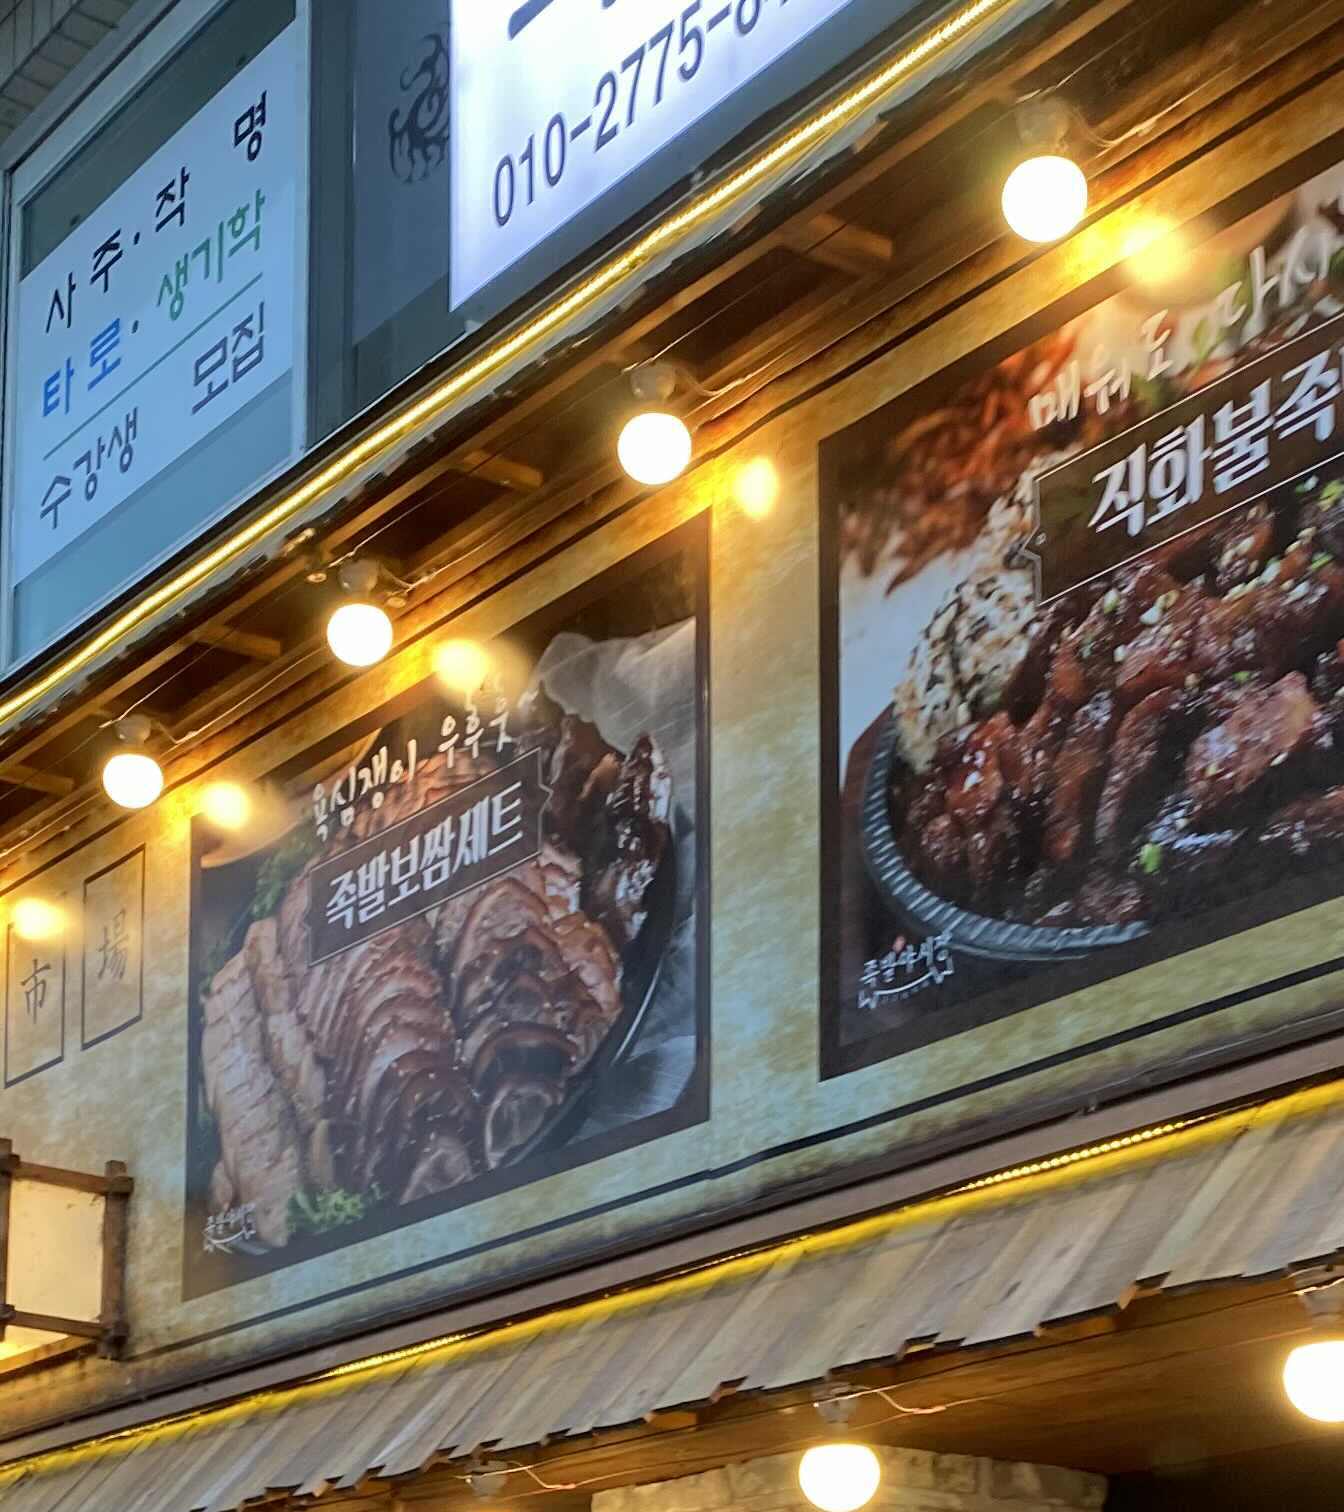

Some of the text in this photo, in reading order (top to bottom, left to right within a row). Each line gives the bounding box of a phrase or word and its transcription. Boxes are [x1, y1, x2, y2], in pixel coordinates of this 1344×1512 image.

[40, 302, 265, 532] 수강생 모집
[312, 739, 417, 843] 욕심쟁이
[325, 781, 524, 930] 족발보쌈세트
